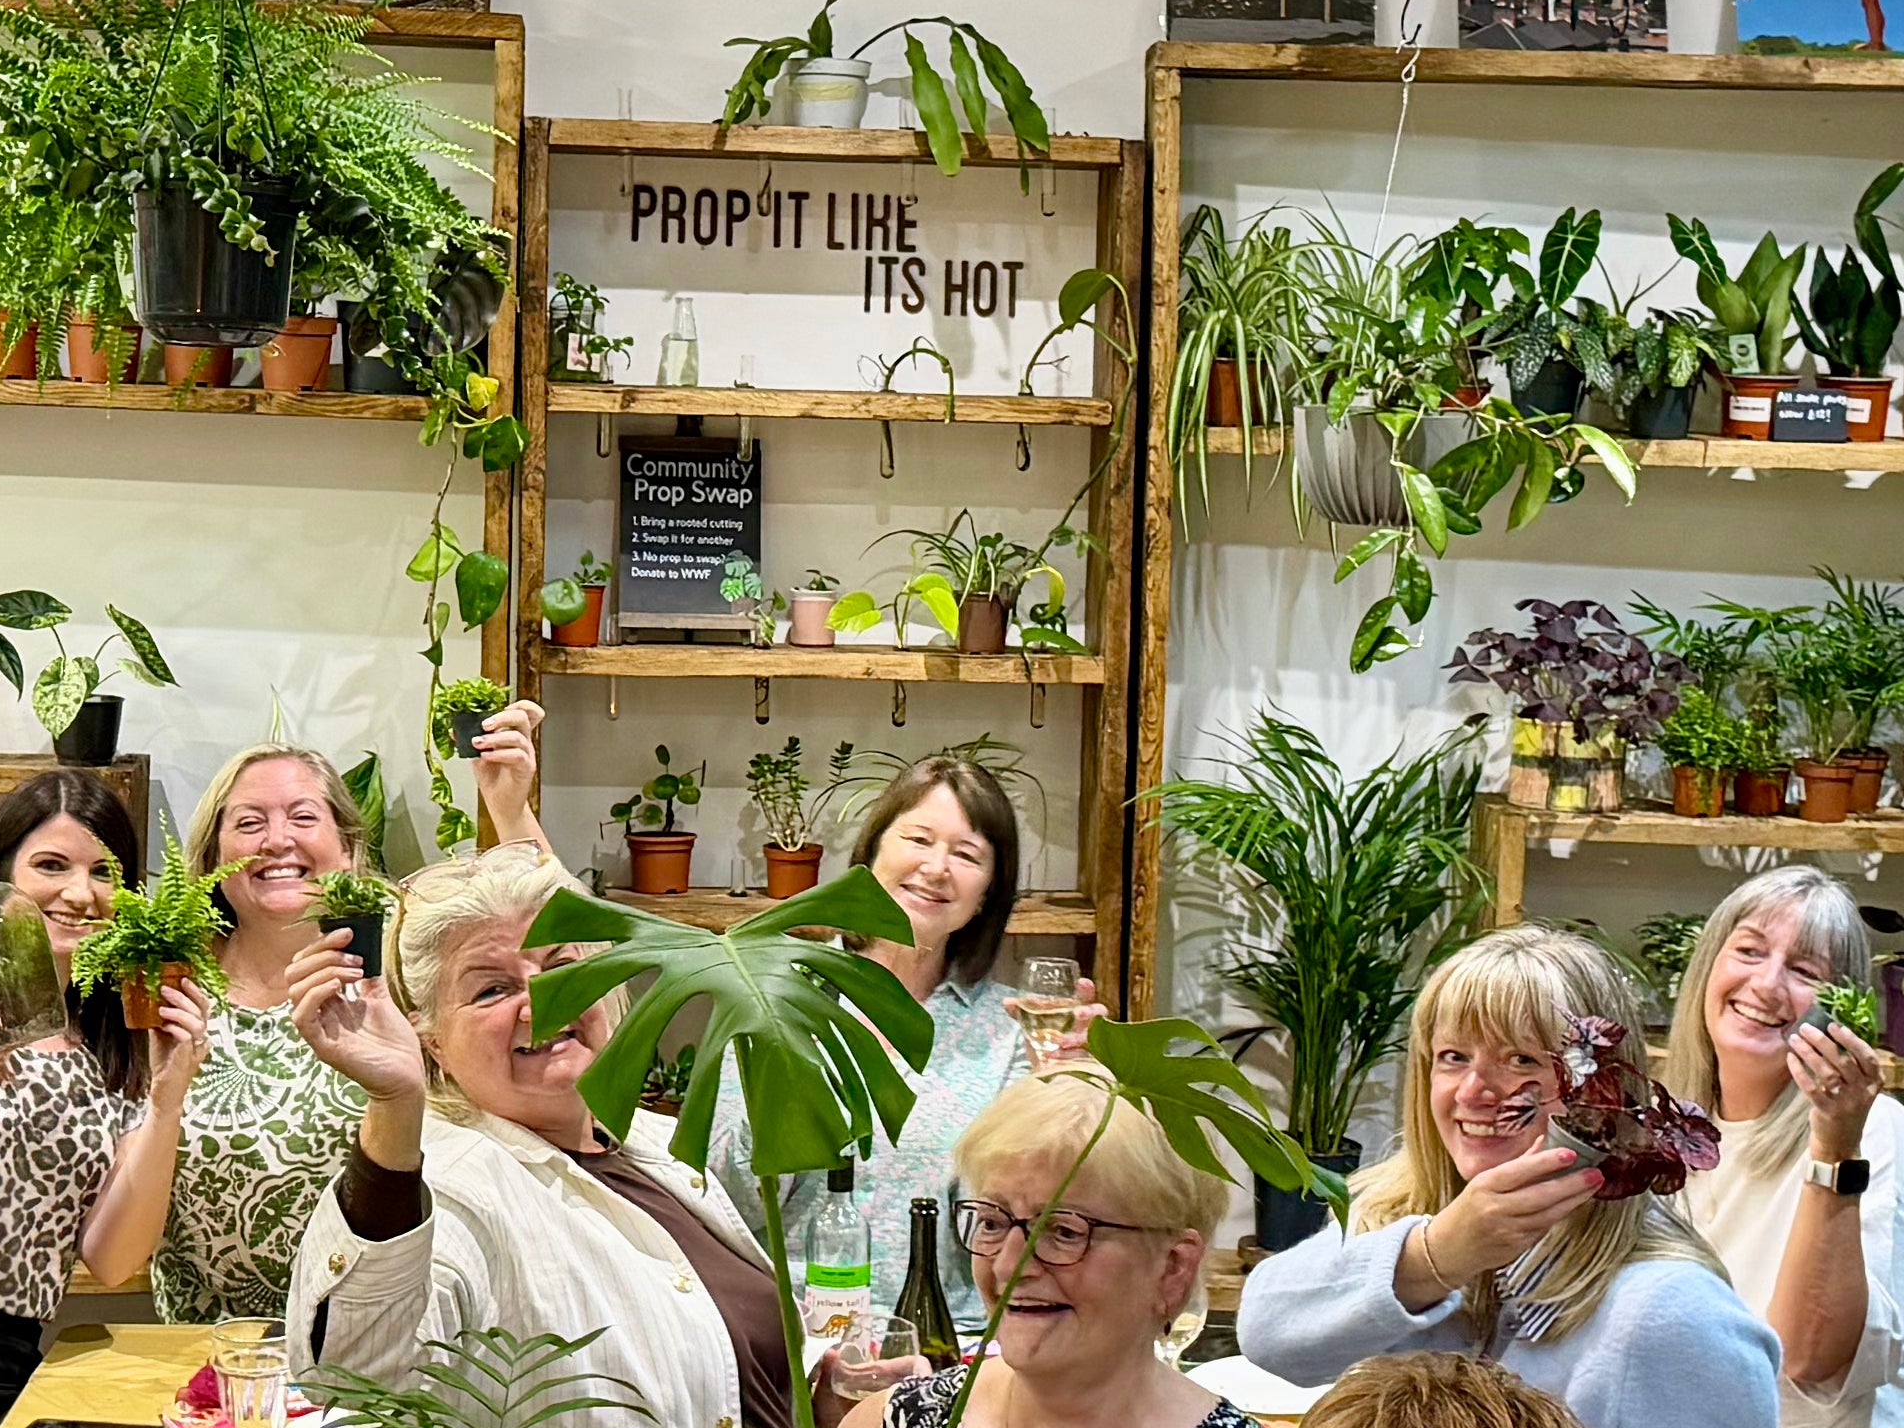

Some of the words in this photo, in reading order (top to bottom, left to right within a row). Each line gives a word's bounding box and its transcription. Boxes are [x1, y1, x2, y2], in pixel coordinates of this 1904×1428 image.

[631, 184, 751, 248] PROP
[773, 190, 810, 249] IT
[827, 192, 918, 252] LIKE
[863, 256, 926, 315] ITS
[944, 260, 1024, 318] HOT
[627, 453, 754, 485] Community
[634, 478, 685, 507] Prop
[691, 480, 753, 509] Swap
[640, 515, 667, 530] Bring
[668, 519, 675, 528] a
[676, 517, 708, 529] rooted
[709, 518, 744, 532] cutting
[642, 532, 670, 546] Swap
[671, 533, 678, 544] it
[680, 533, 694, 545] for
[697, 535, 734, 547] another
[642, 551, 658, 562] No
[659, 554, 682, 566] prop
[683, 553, 694, 564] to
[695, 554, 726, 567] swap?
[631, 566, 667, 579] Donate
[668, 568, 679, 580] to
[680, 568, 712, 580] WWF
